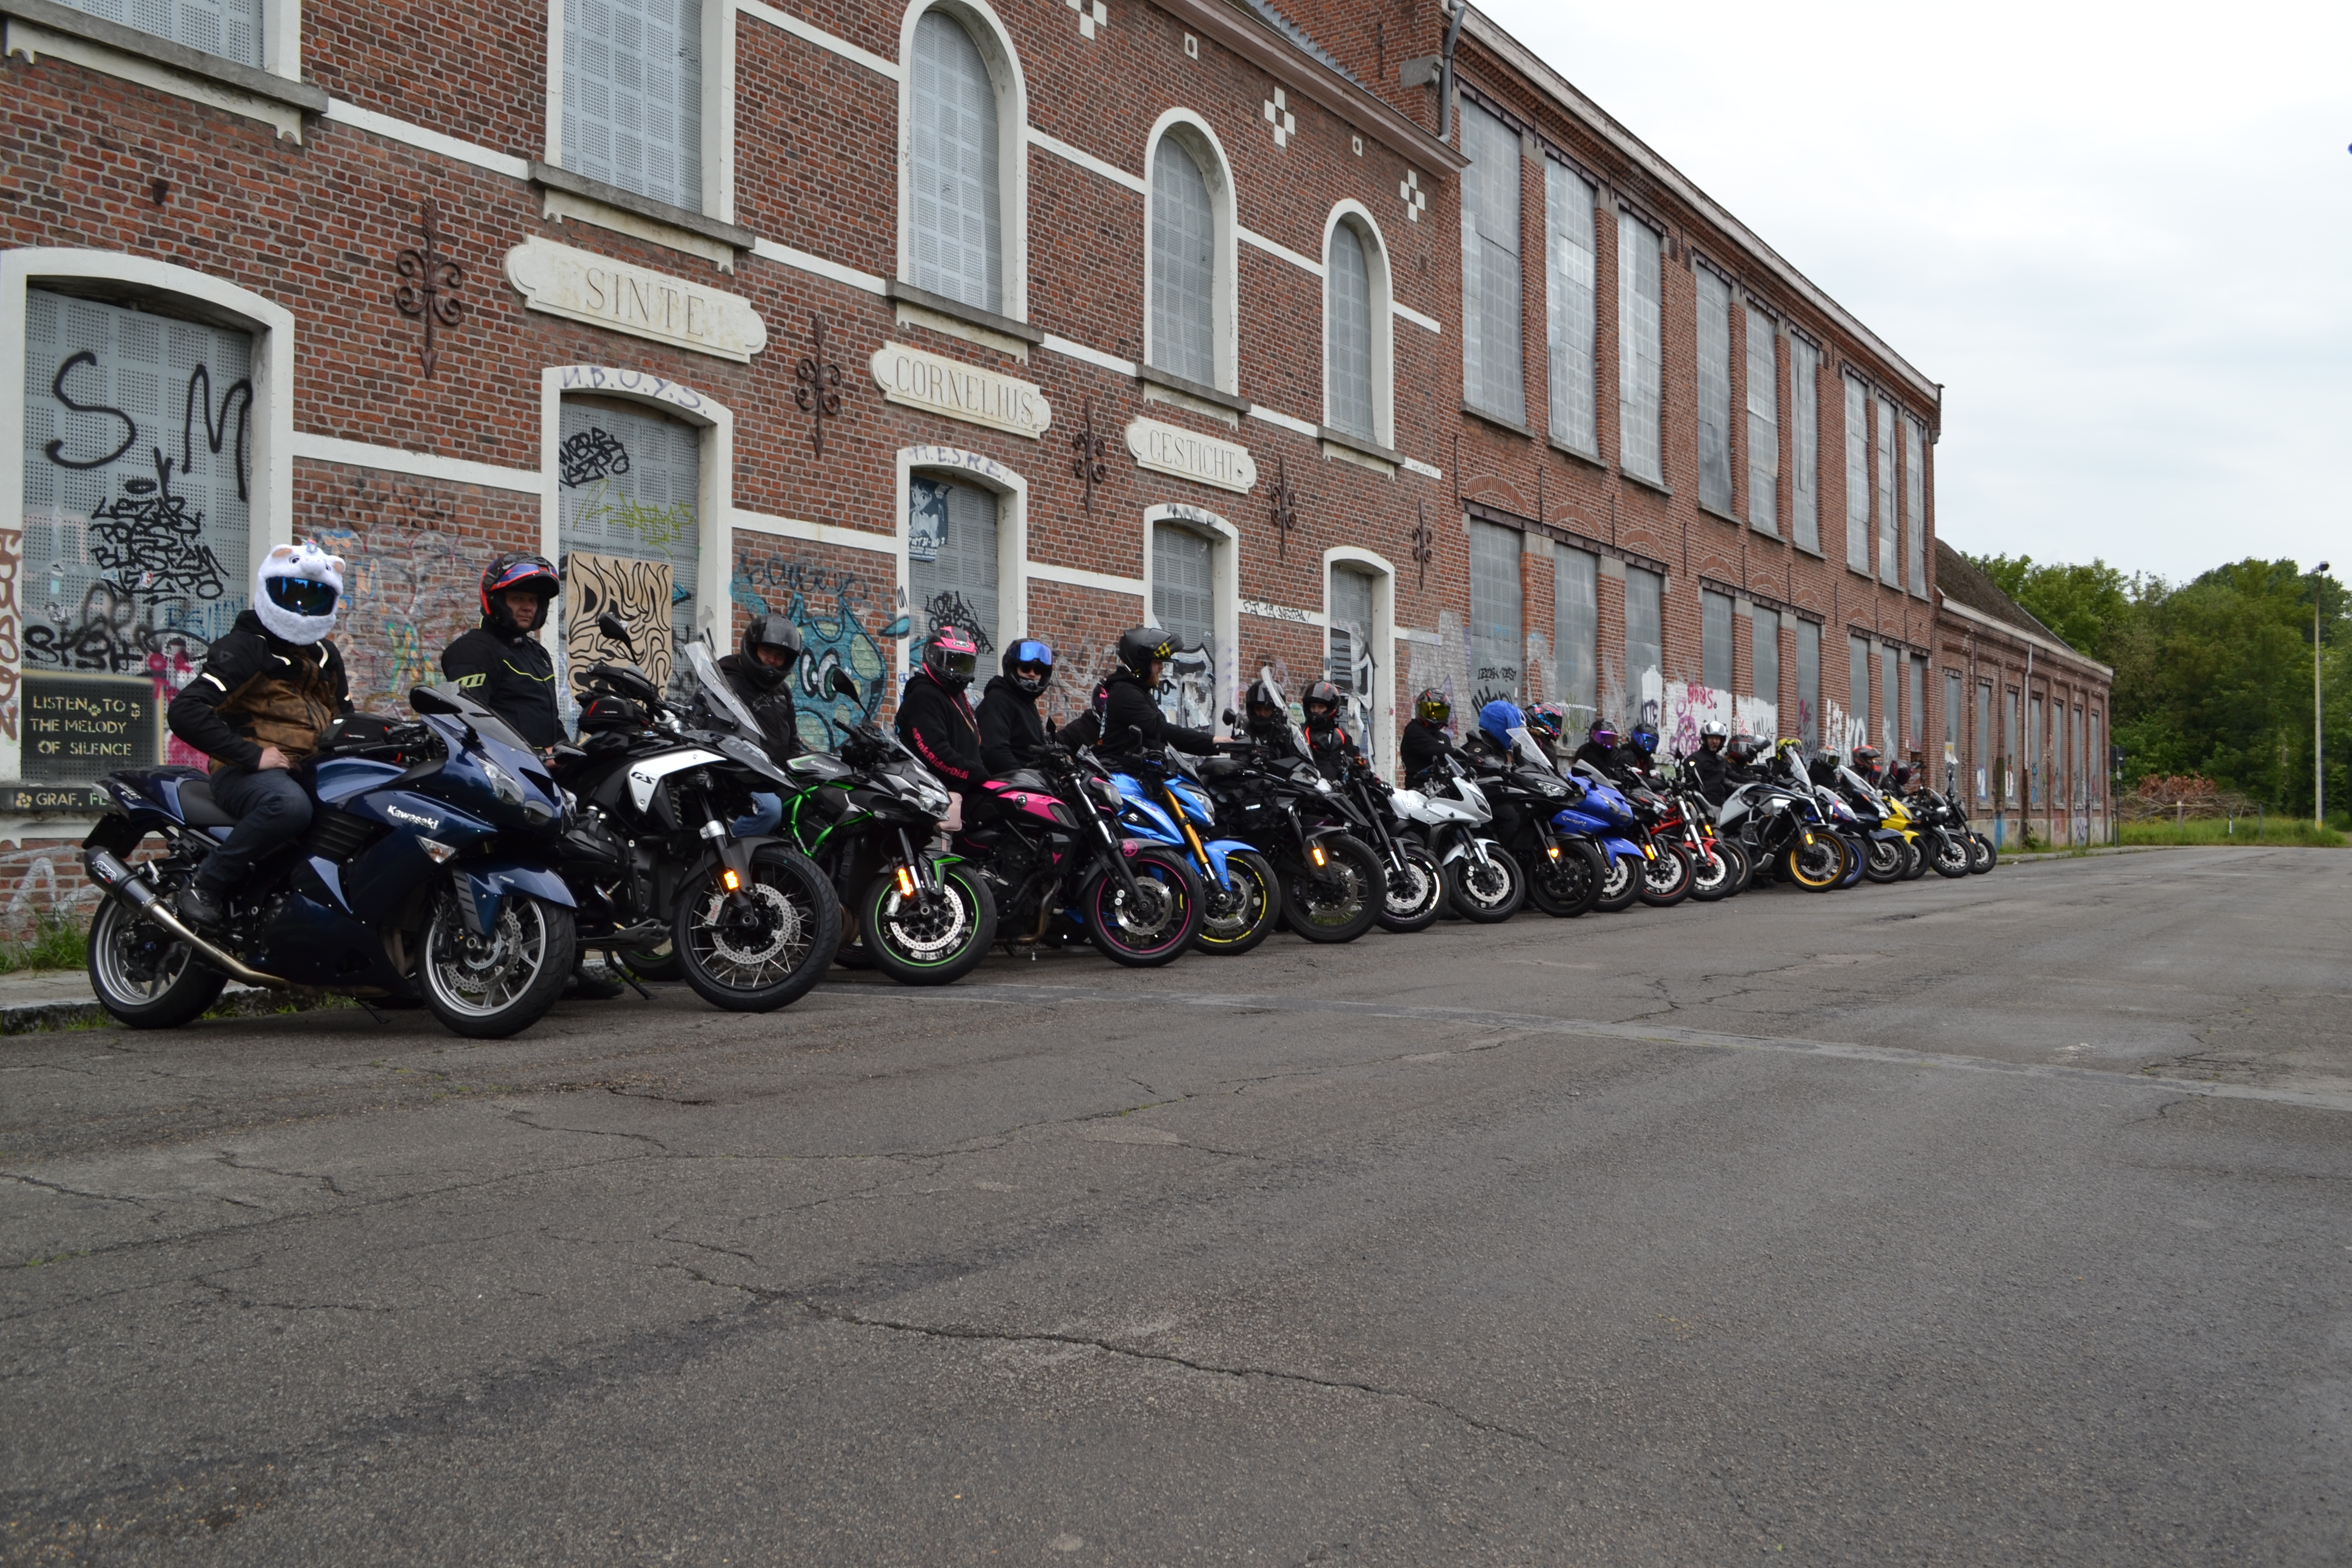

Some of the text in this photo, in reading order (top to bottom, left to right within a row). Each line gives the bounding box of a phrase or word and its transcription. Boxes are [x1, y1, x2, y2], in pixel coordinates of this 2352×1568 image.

[586, 267, 704, 337] SINTE
[896, 355, 1034, 425] CORNELIUS
[33, 696, 126, 712] LISTEN TO
[30, 718, 127, 734] THE MELODY
[38, 740, 132, 756] OF SILENCE
[912, 727, 969, 780] @PinkRiderDidi
[36, 793, 83, 806] GRAF.
[387, 804, 439, 830] Kawasaki
